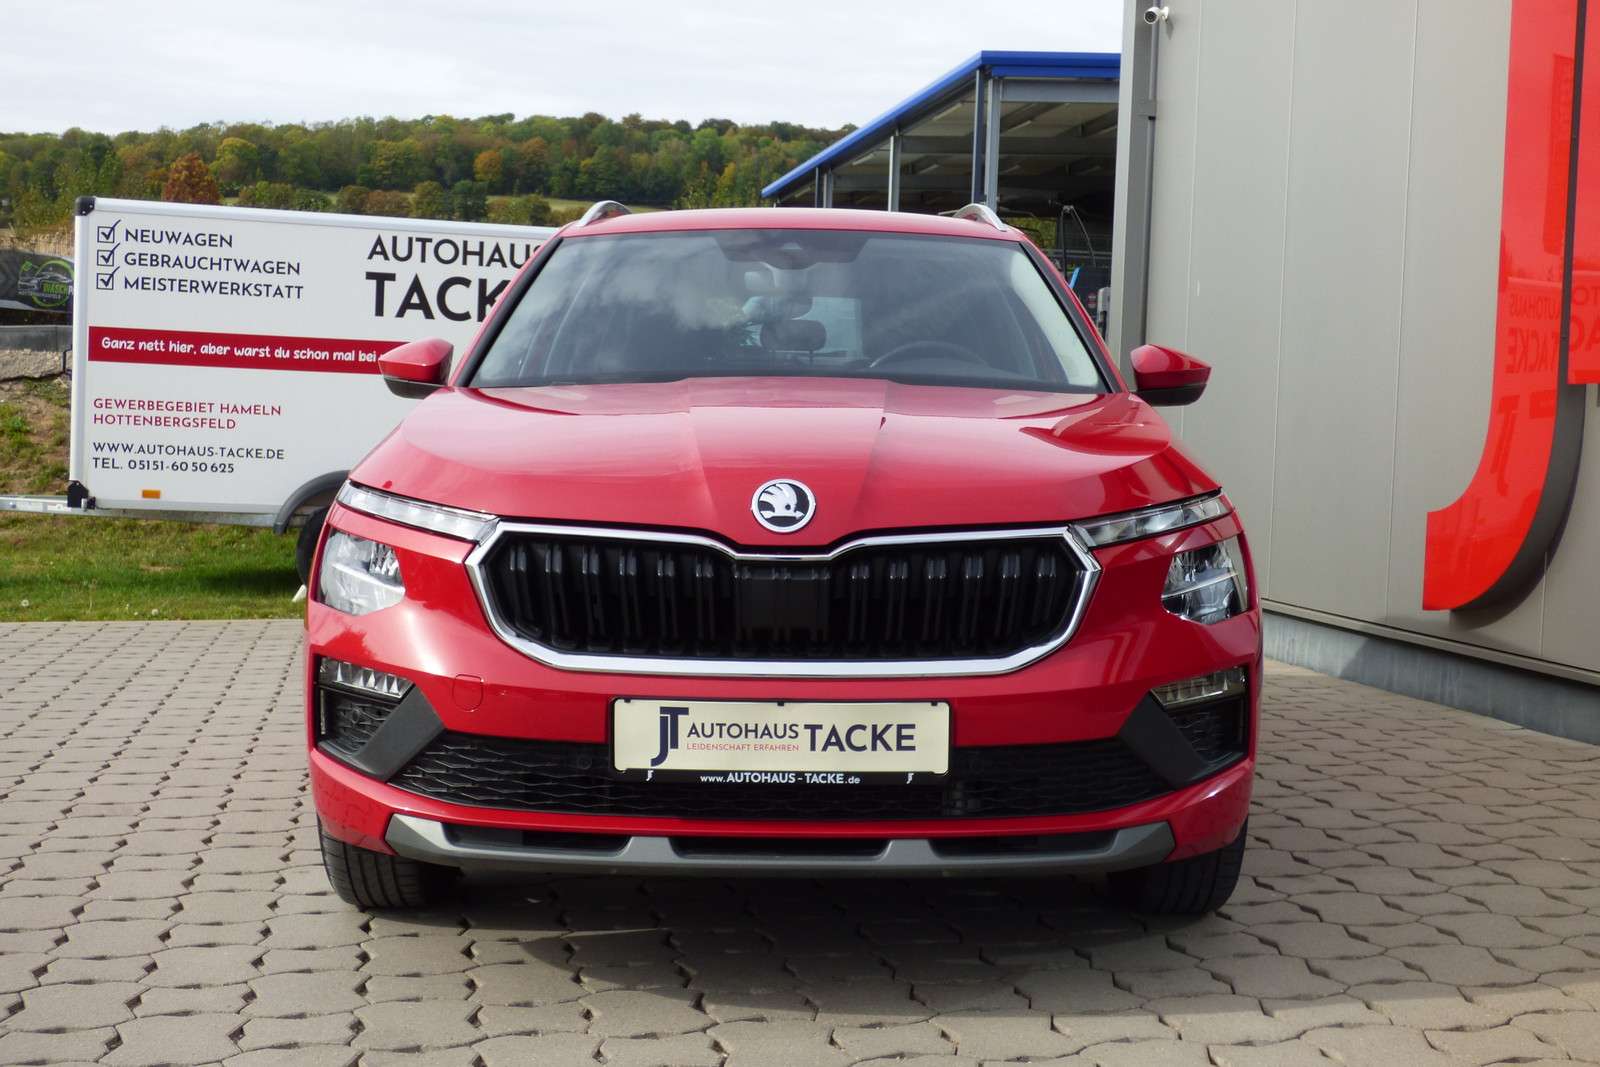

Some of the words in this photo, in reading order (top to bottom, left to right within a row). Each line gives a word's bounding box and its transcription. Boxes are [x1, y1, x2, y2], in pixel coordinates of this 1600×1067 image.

[125, 228, 233, 248] NEUWAGEN
[367, 234, 543, 269] AUTOHAU
[124, 252, 301, 275] GEBRAUCHTWAGEN
[124, 276, 304, 299] MEISTERWERKSTATT
[101, 336, 135, 350] Ganz
[138, 339, 165, 351] nett
[200, 342, 230, 355] aber
[233, 346, 271, 357] warst
[274, 346, 290, 359] du
[293, 348, 329, 360] schon
[333, 350, 355, 361] mal
[358, 350, 377, 362] bei
[93, 398, 214, 413] GEWERBEGEBIET
[220, 403, 281, 416] HAMELN
[93, 414, 236, 429] HOTTENBERGSFELD
[93, 442, 285, 460] WWW.AUTOHAUS-TACKE.DE
[93, 457, 123, 470] TEL.
[687, 722, 800, 740] AUTOHAUS
[804, 724, 916, 752] TACKE
[687, 743, 751, 751] LEIDENSCHAFT
[753, 744, 800, 752] ERFAHREN
